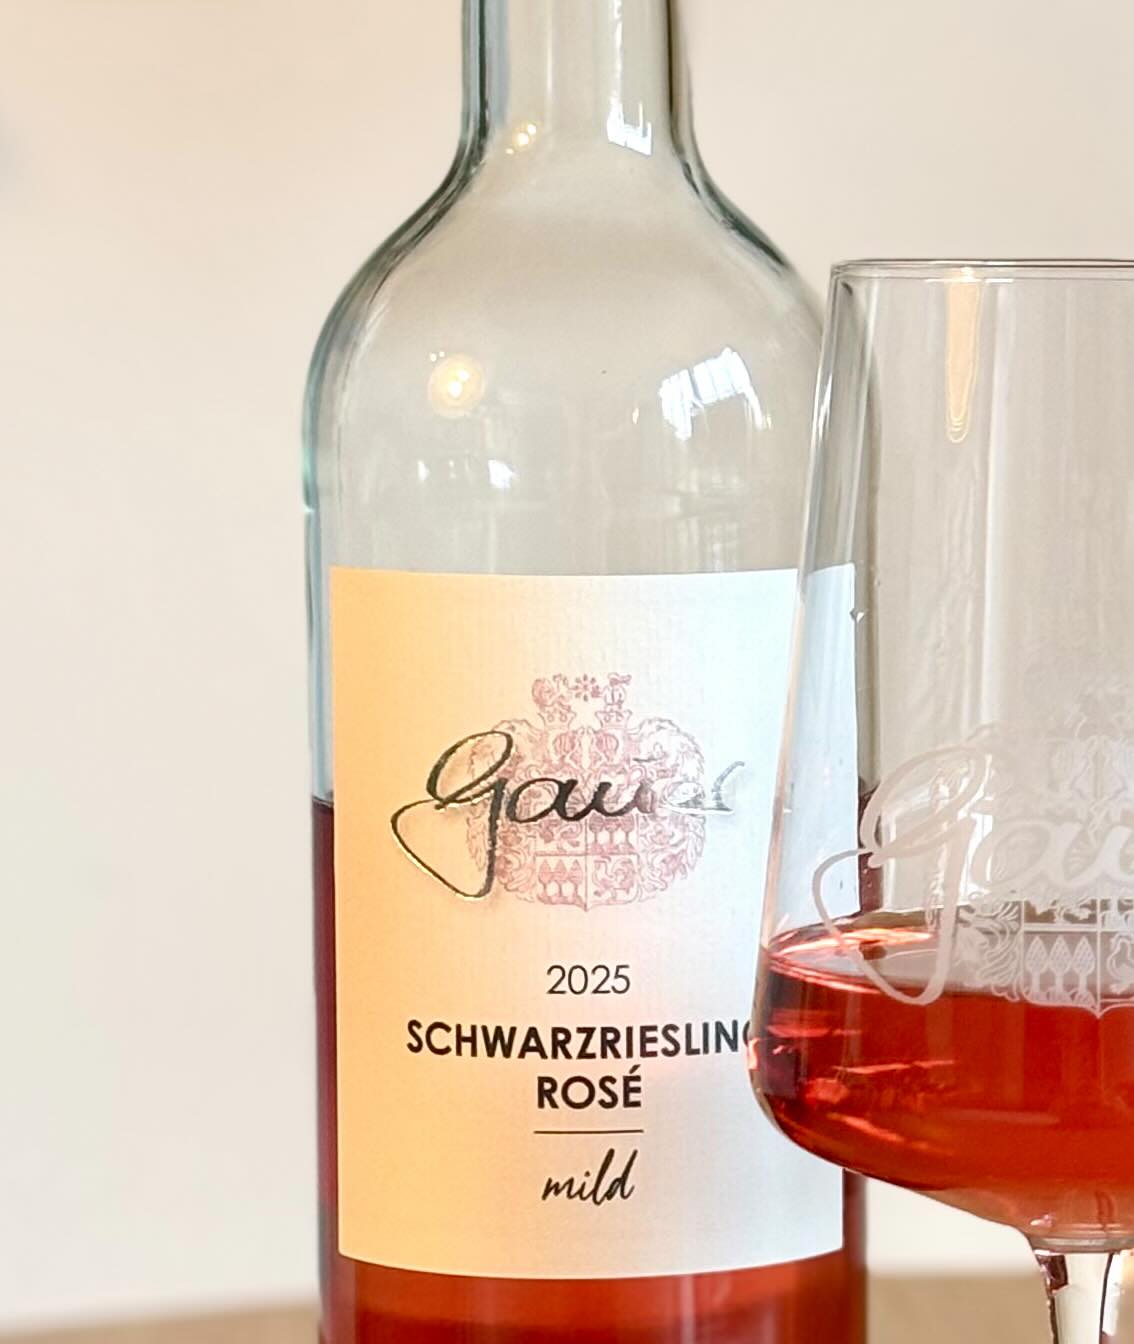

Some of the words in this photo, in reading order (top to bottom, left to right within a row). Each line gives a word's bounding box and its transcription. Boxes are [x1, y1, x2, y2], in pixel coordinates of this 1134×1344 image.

[546, 964, 631, 995] 2025
[406, 1018, 751, 1060] SCHWARZRIESLIN
[536, 1064, 643, 1110] ROSÉ
[541, 1148, 639, 1206] mild
